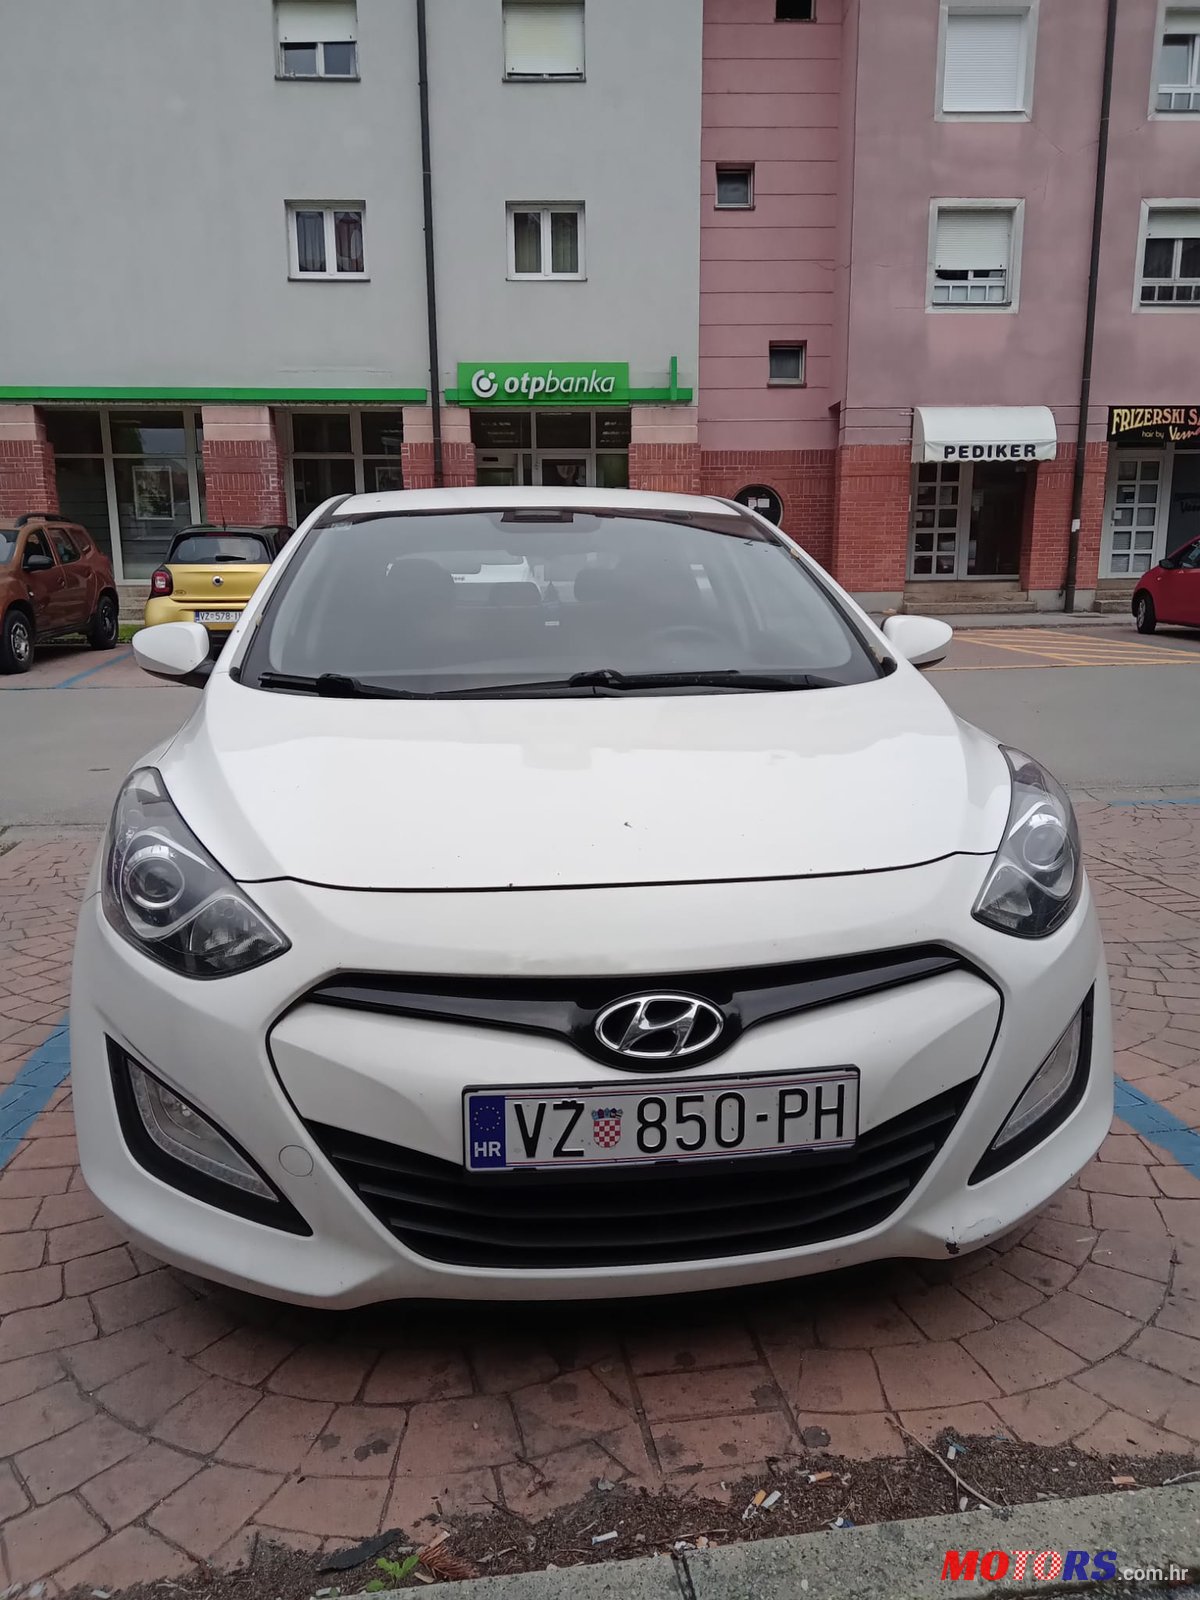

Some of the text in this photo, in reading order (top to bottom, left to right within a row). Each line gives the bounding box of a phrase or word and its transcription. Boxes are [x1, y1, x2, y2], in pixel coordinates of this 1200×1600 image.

[504, 369, 615, 399] otpbanka
[1111, 408, 1185, 435] FRIZERSKI
[1141, 430, 1154, 438] hair
[1155, 430, 1165, 439] by
[944, 444, 1036, 459] PEDIKER
[474, 1141, 501, 1157] HR
[637, 1083, 845, 1154] 850-PH
